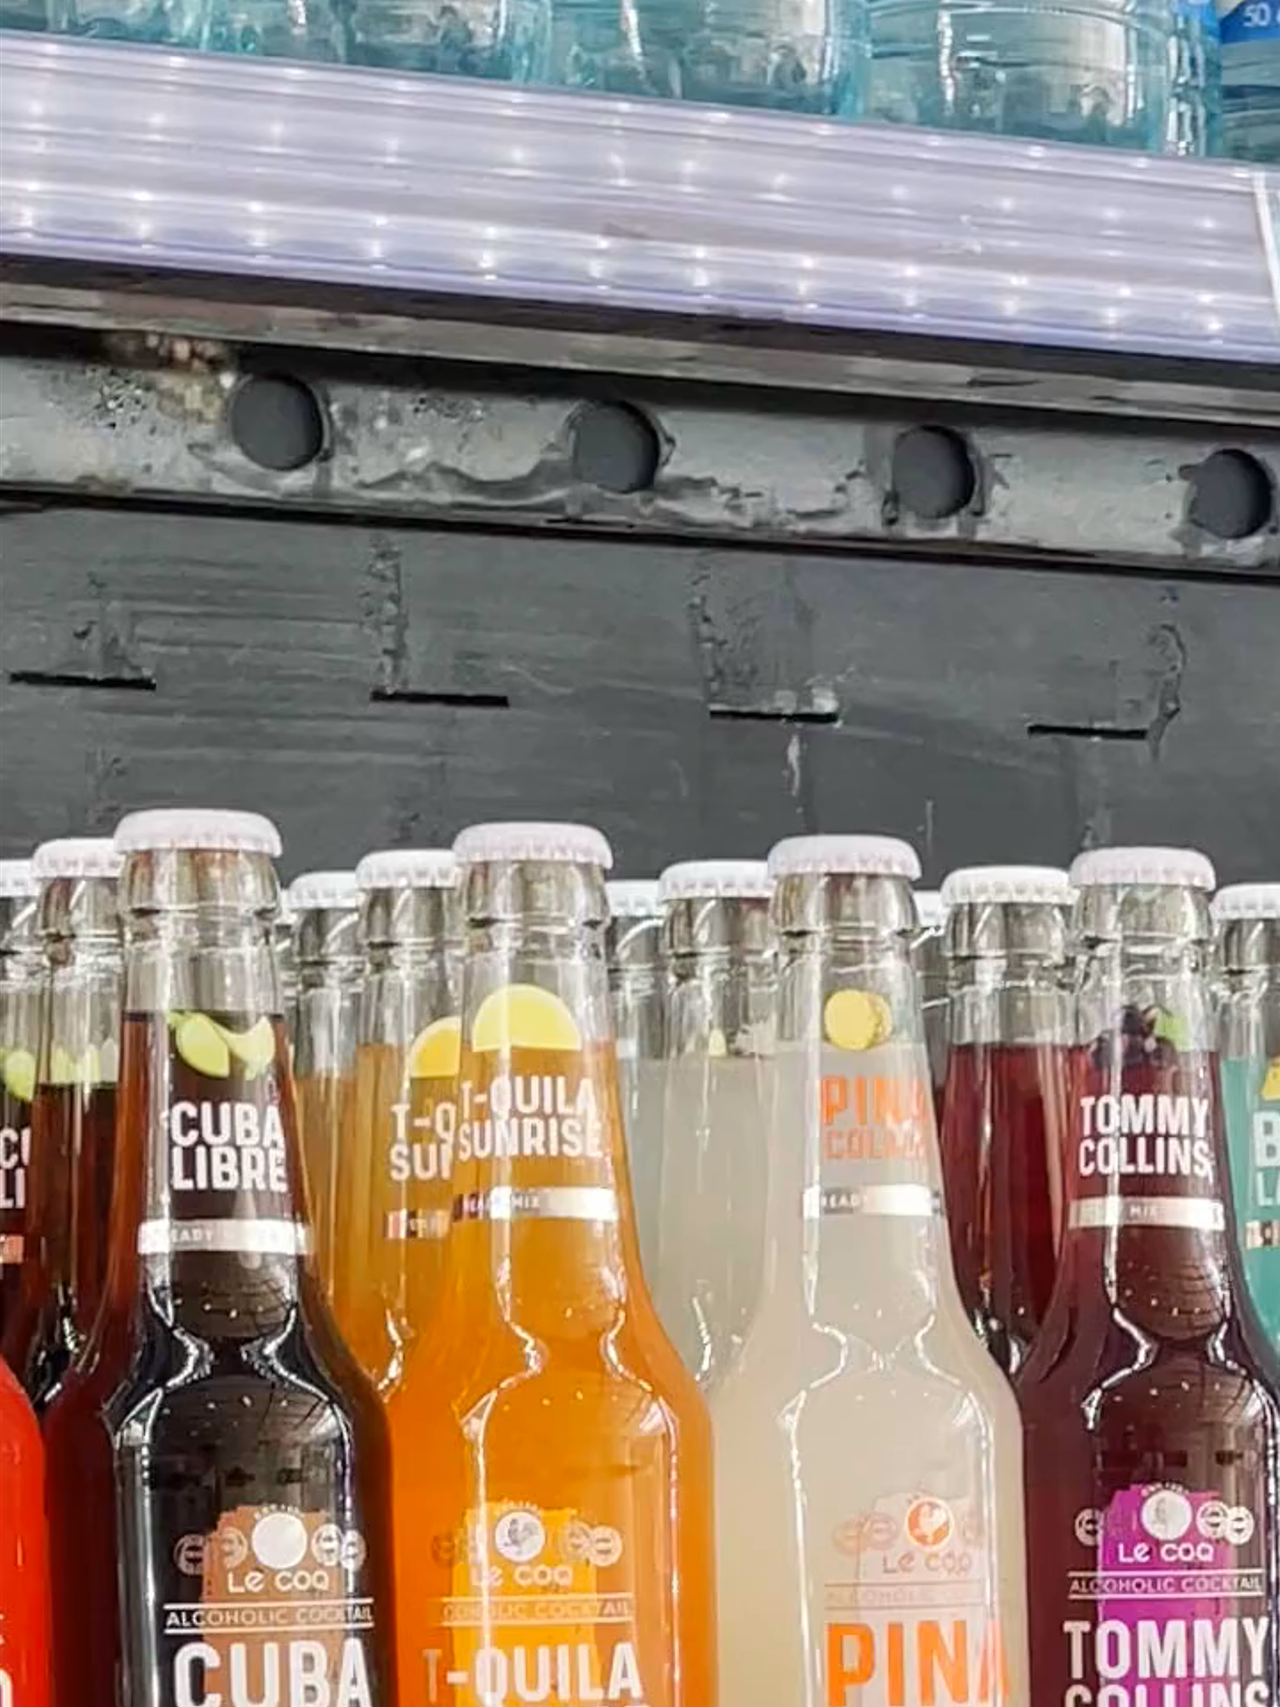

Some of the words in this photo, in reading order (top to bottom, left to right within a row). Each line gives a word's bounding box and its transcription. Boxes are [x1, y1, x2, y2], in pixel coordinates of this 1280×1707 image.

[1245, 3, 1271, 27] 50
[461, 1076, 598, 1118] T-QUILA
[1080, 1096, 1209, 1138] TOMMY
[169, 1101, 286, 1148] CUBA
[457, 1117, 602, 1162] SUNRISE
[171, 1148, 288, 1192] LIBRE
[1079, 1139, 1211, 1177] COLLINS
[1070, 1578, 1175, 1594] ALCOHOLIC
[1181, 1574, 1262, 1592] COCKTAIL
[166, 1608, 288, 1628] ALCOHOLIC
[295, 1604, 372, 1625] COCKTAIL
[827, 1619, 1010, 1707] PINA
[1064, 1618, 1270, 1681] TOMMY
[423, 1641, 643, 1704] T-QUILA
